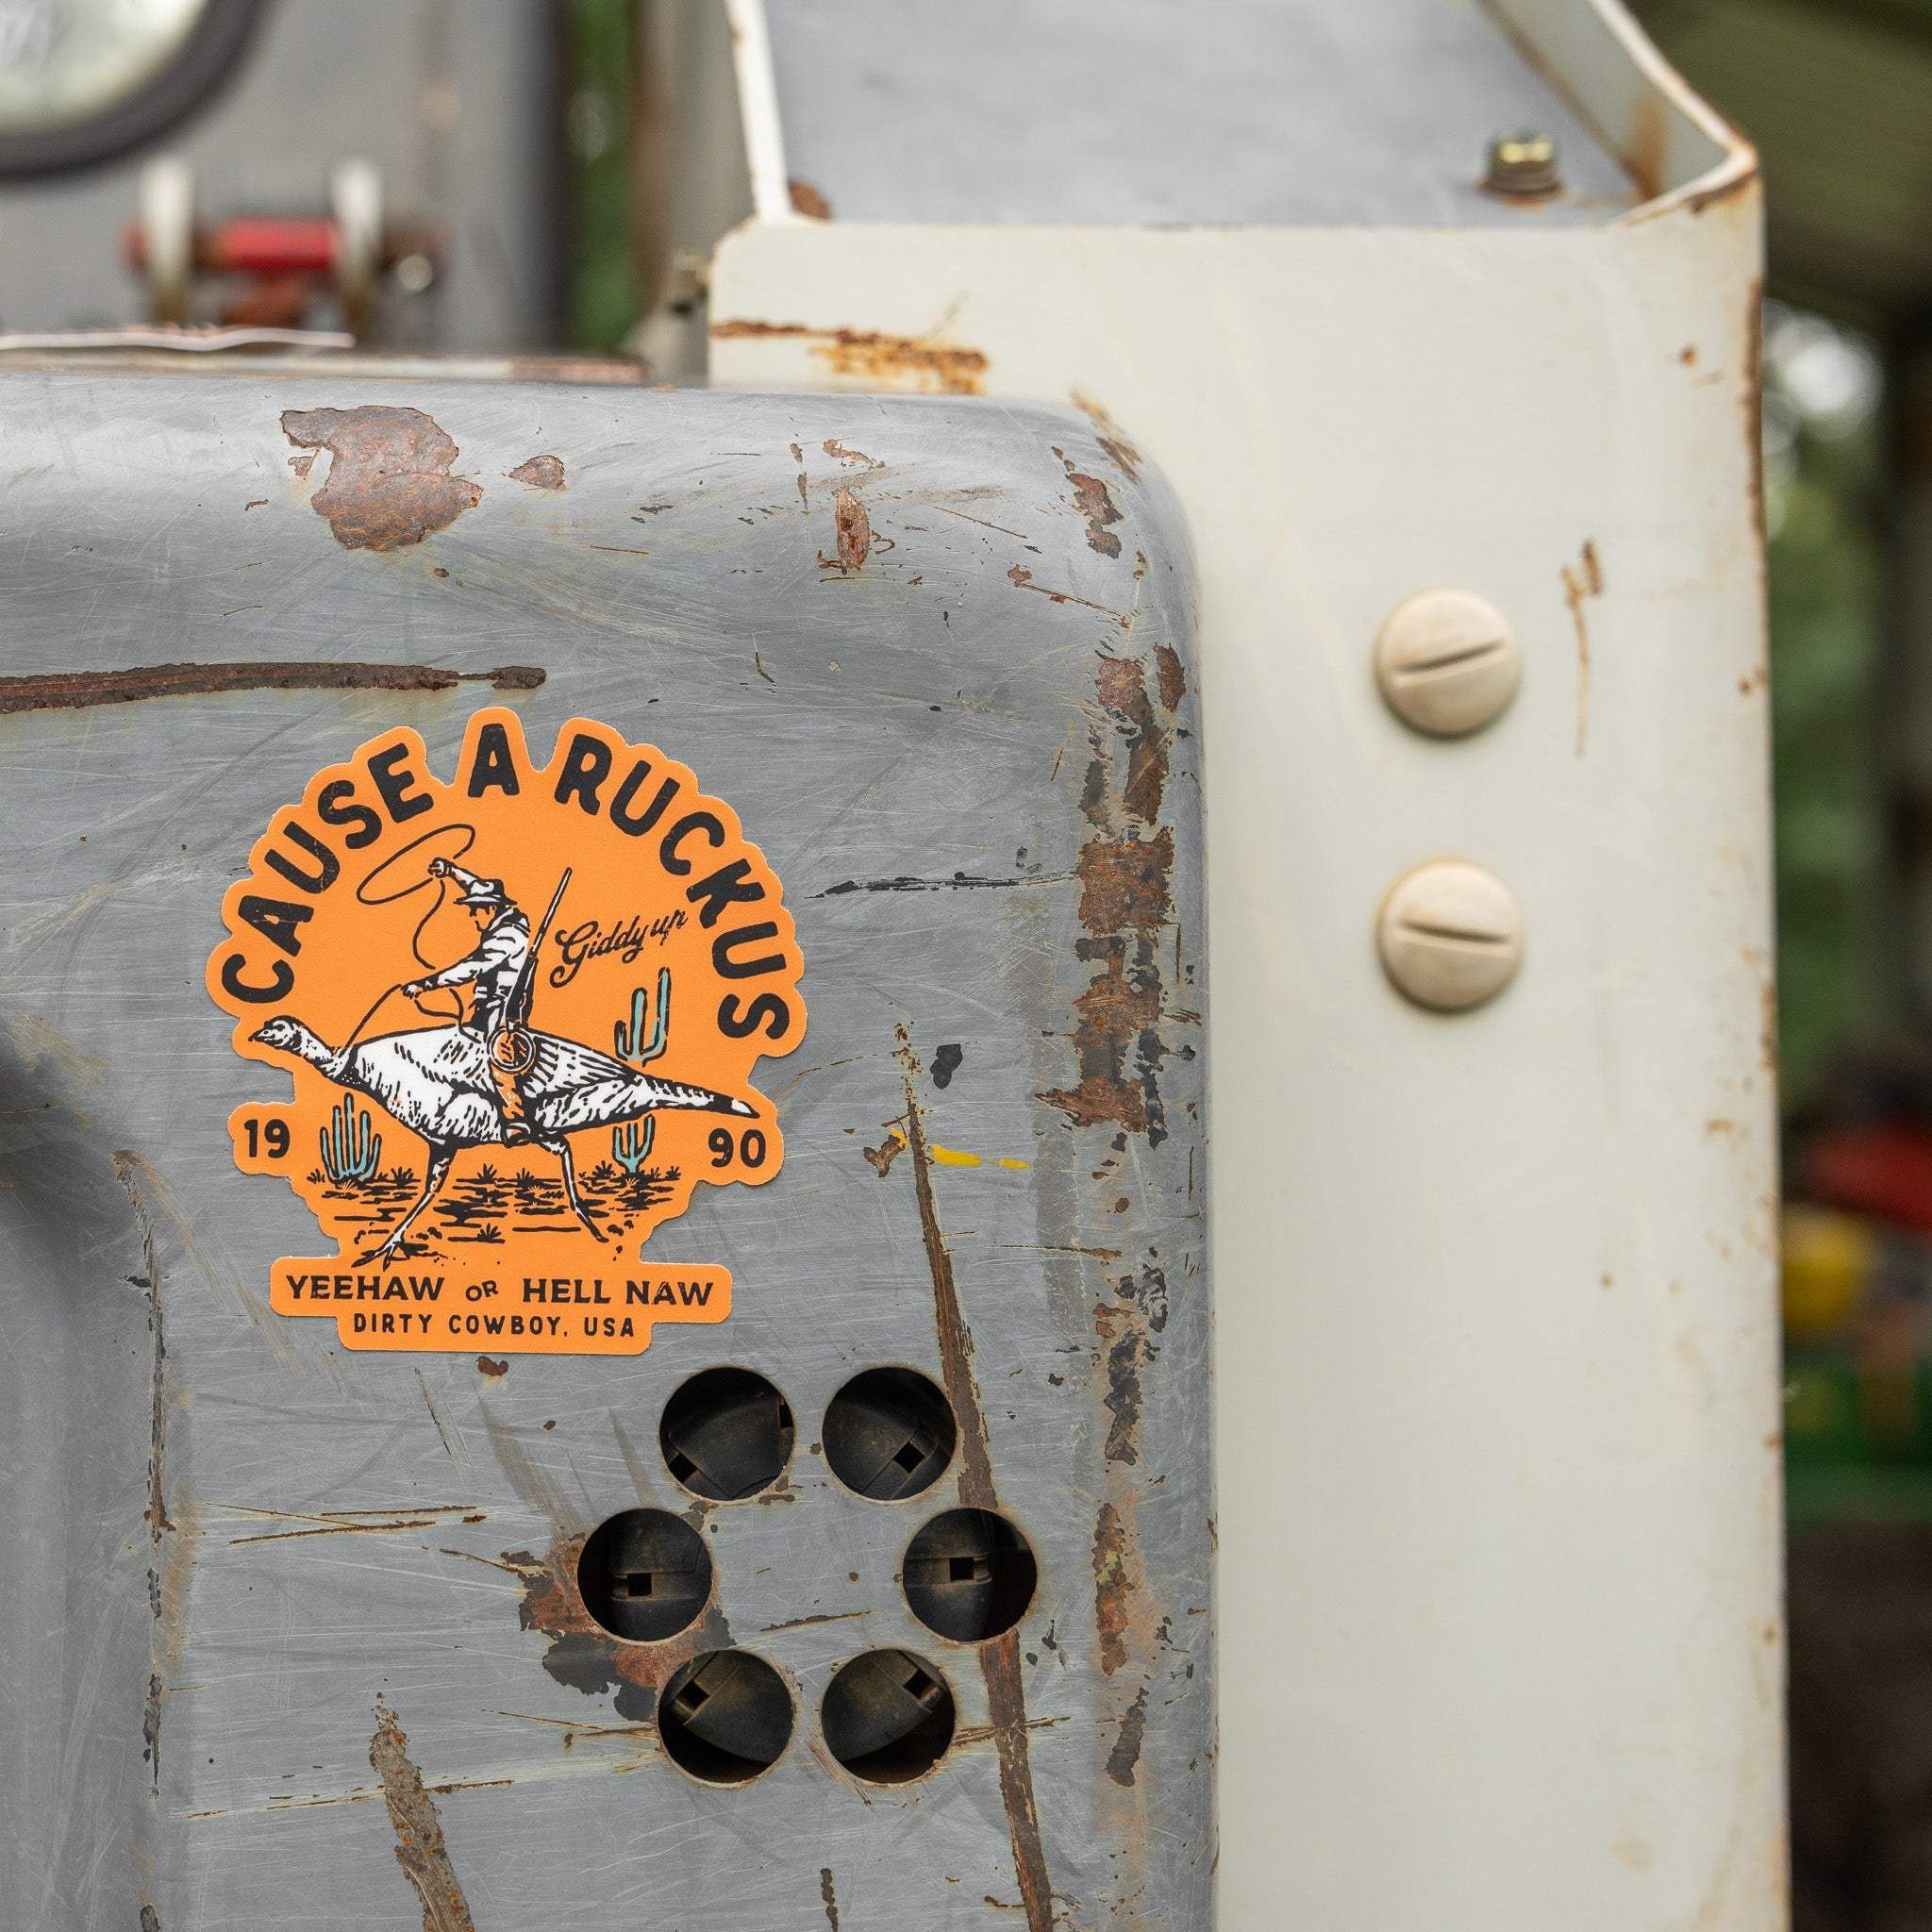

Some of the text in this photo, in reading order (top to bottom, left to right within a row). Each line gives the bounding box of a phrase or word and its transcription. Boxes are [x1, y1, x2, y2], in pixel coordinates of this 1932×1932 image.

[222, 724, 790, 1039] CAUSE A RUCKUS
[244, 1120, 290, 1158] 19
[708, 1128, 765, 1167] 90
[287, 1275, 444, 1300] YEEHAW
[524, 1279, 610, 1303] HELL
[626, 1281, 712, 1306] NAW
[355, 1313, 431, 1332] DIRTY
[585, 1318, 633, 1337] USA
